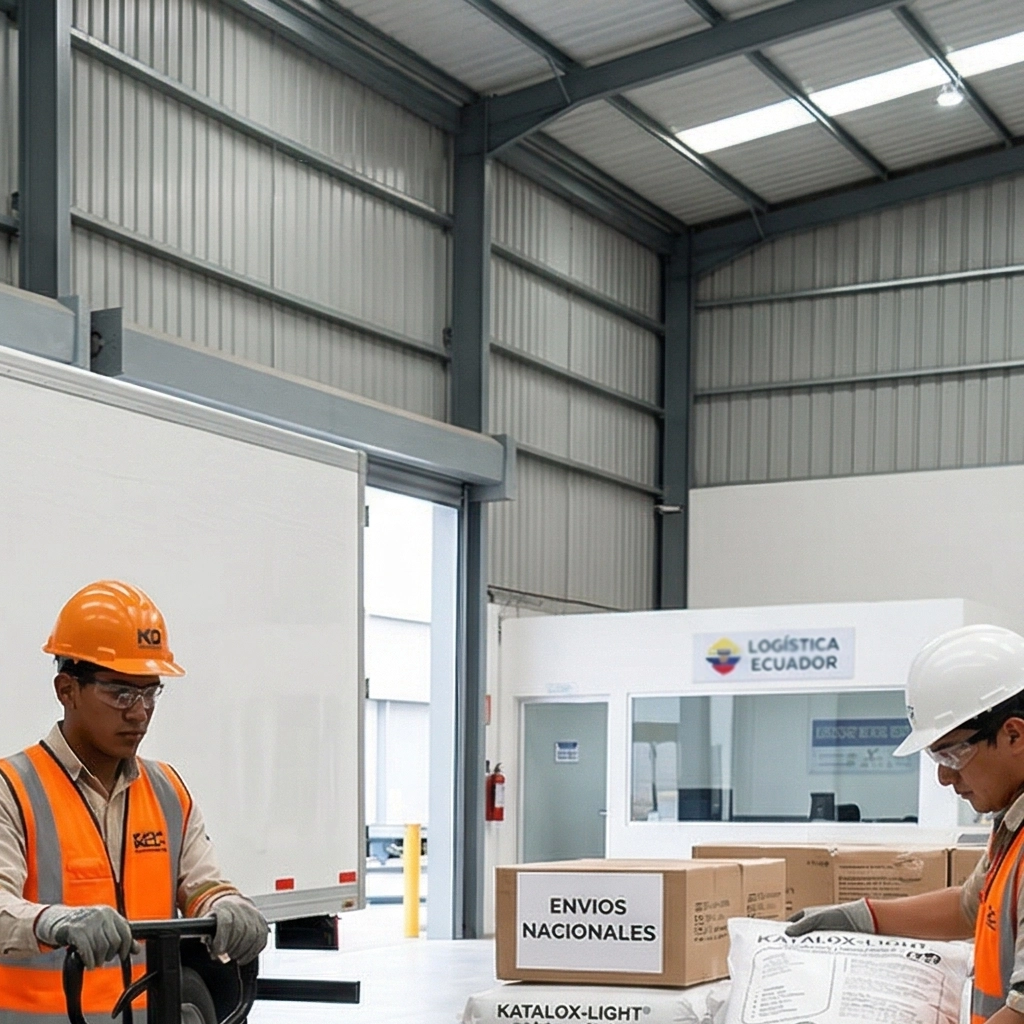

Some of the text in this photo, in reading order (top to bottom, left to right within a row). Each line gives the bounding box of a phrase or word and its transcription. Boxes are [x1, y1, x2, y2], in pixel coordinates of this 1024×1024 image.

[748, 635, 840, 654] LOGÍSTICA
[751, 656, 838, 672] ECUADOR
[550, 898, 627, 916] ENVIOS
[522, 922, 656, 942] NACIONALES
